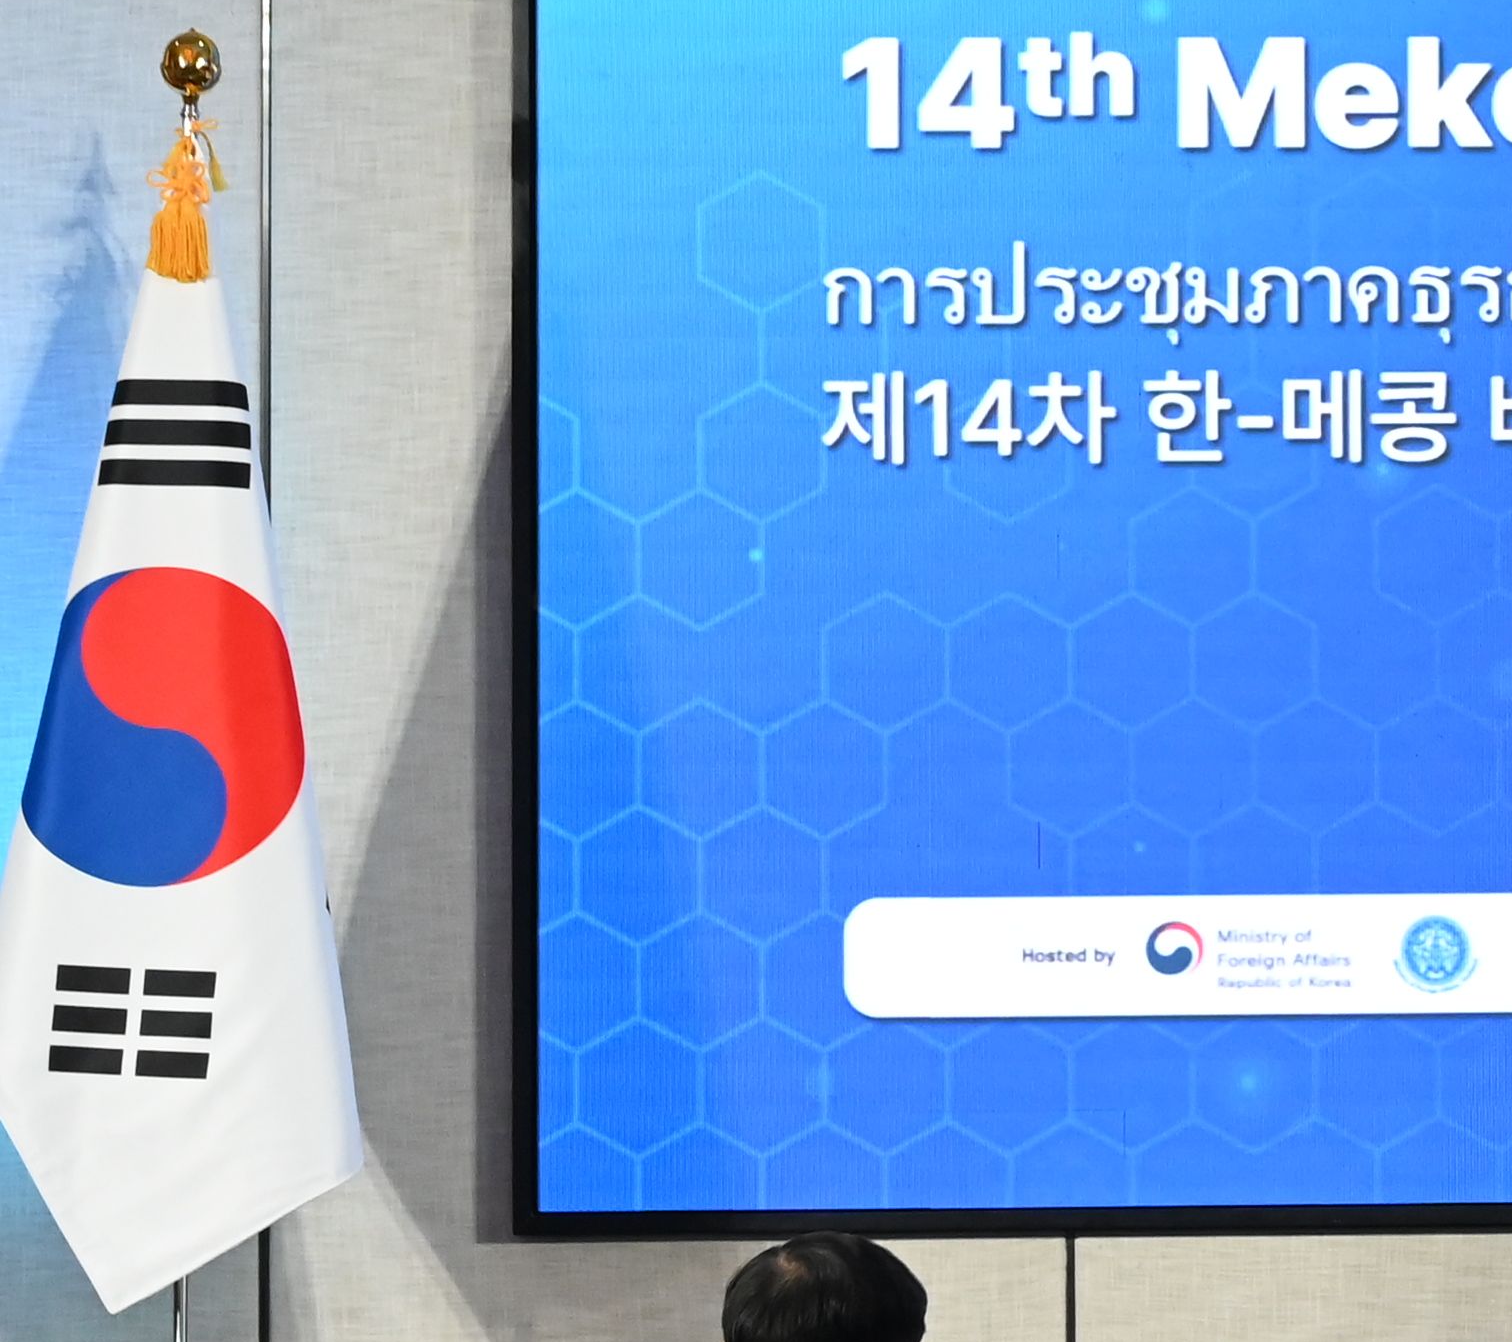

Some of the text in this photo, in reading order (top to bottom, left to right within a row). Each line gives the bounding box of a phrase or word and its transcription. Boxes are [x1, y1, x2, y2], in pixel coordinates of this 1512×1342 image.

[841, 30, 1136, 151] 14th
[821, 369, 1118, 466] 제14차
[1142, 368, 1458, 464] 한-메콩
[1218, 929, 1312, 945] Ministry of
[1022, 947, 1117, 968] Hosted by
[1217, 953, 1352, 970] Foreign Affairs
